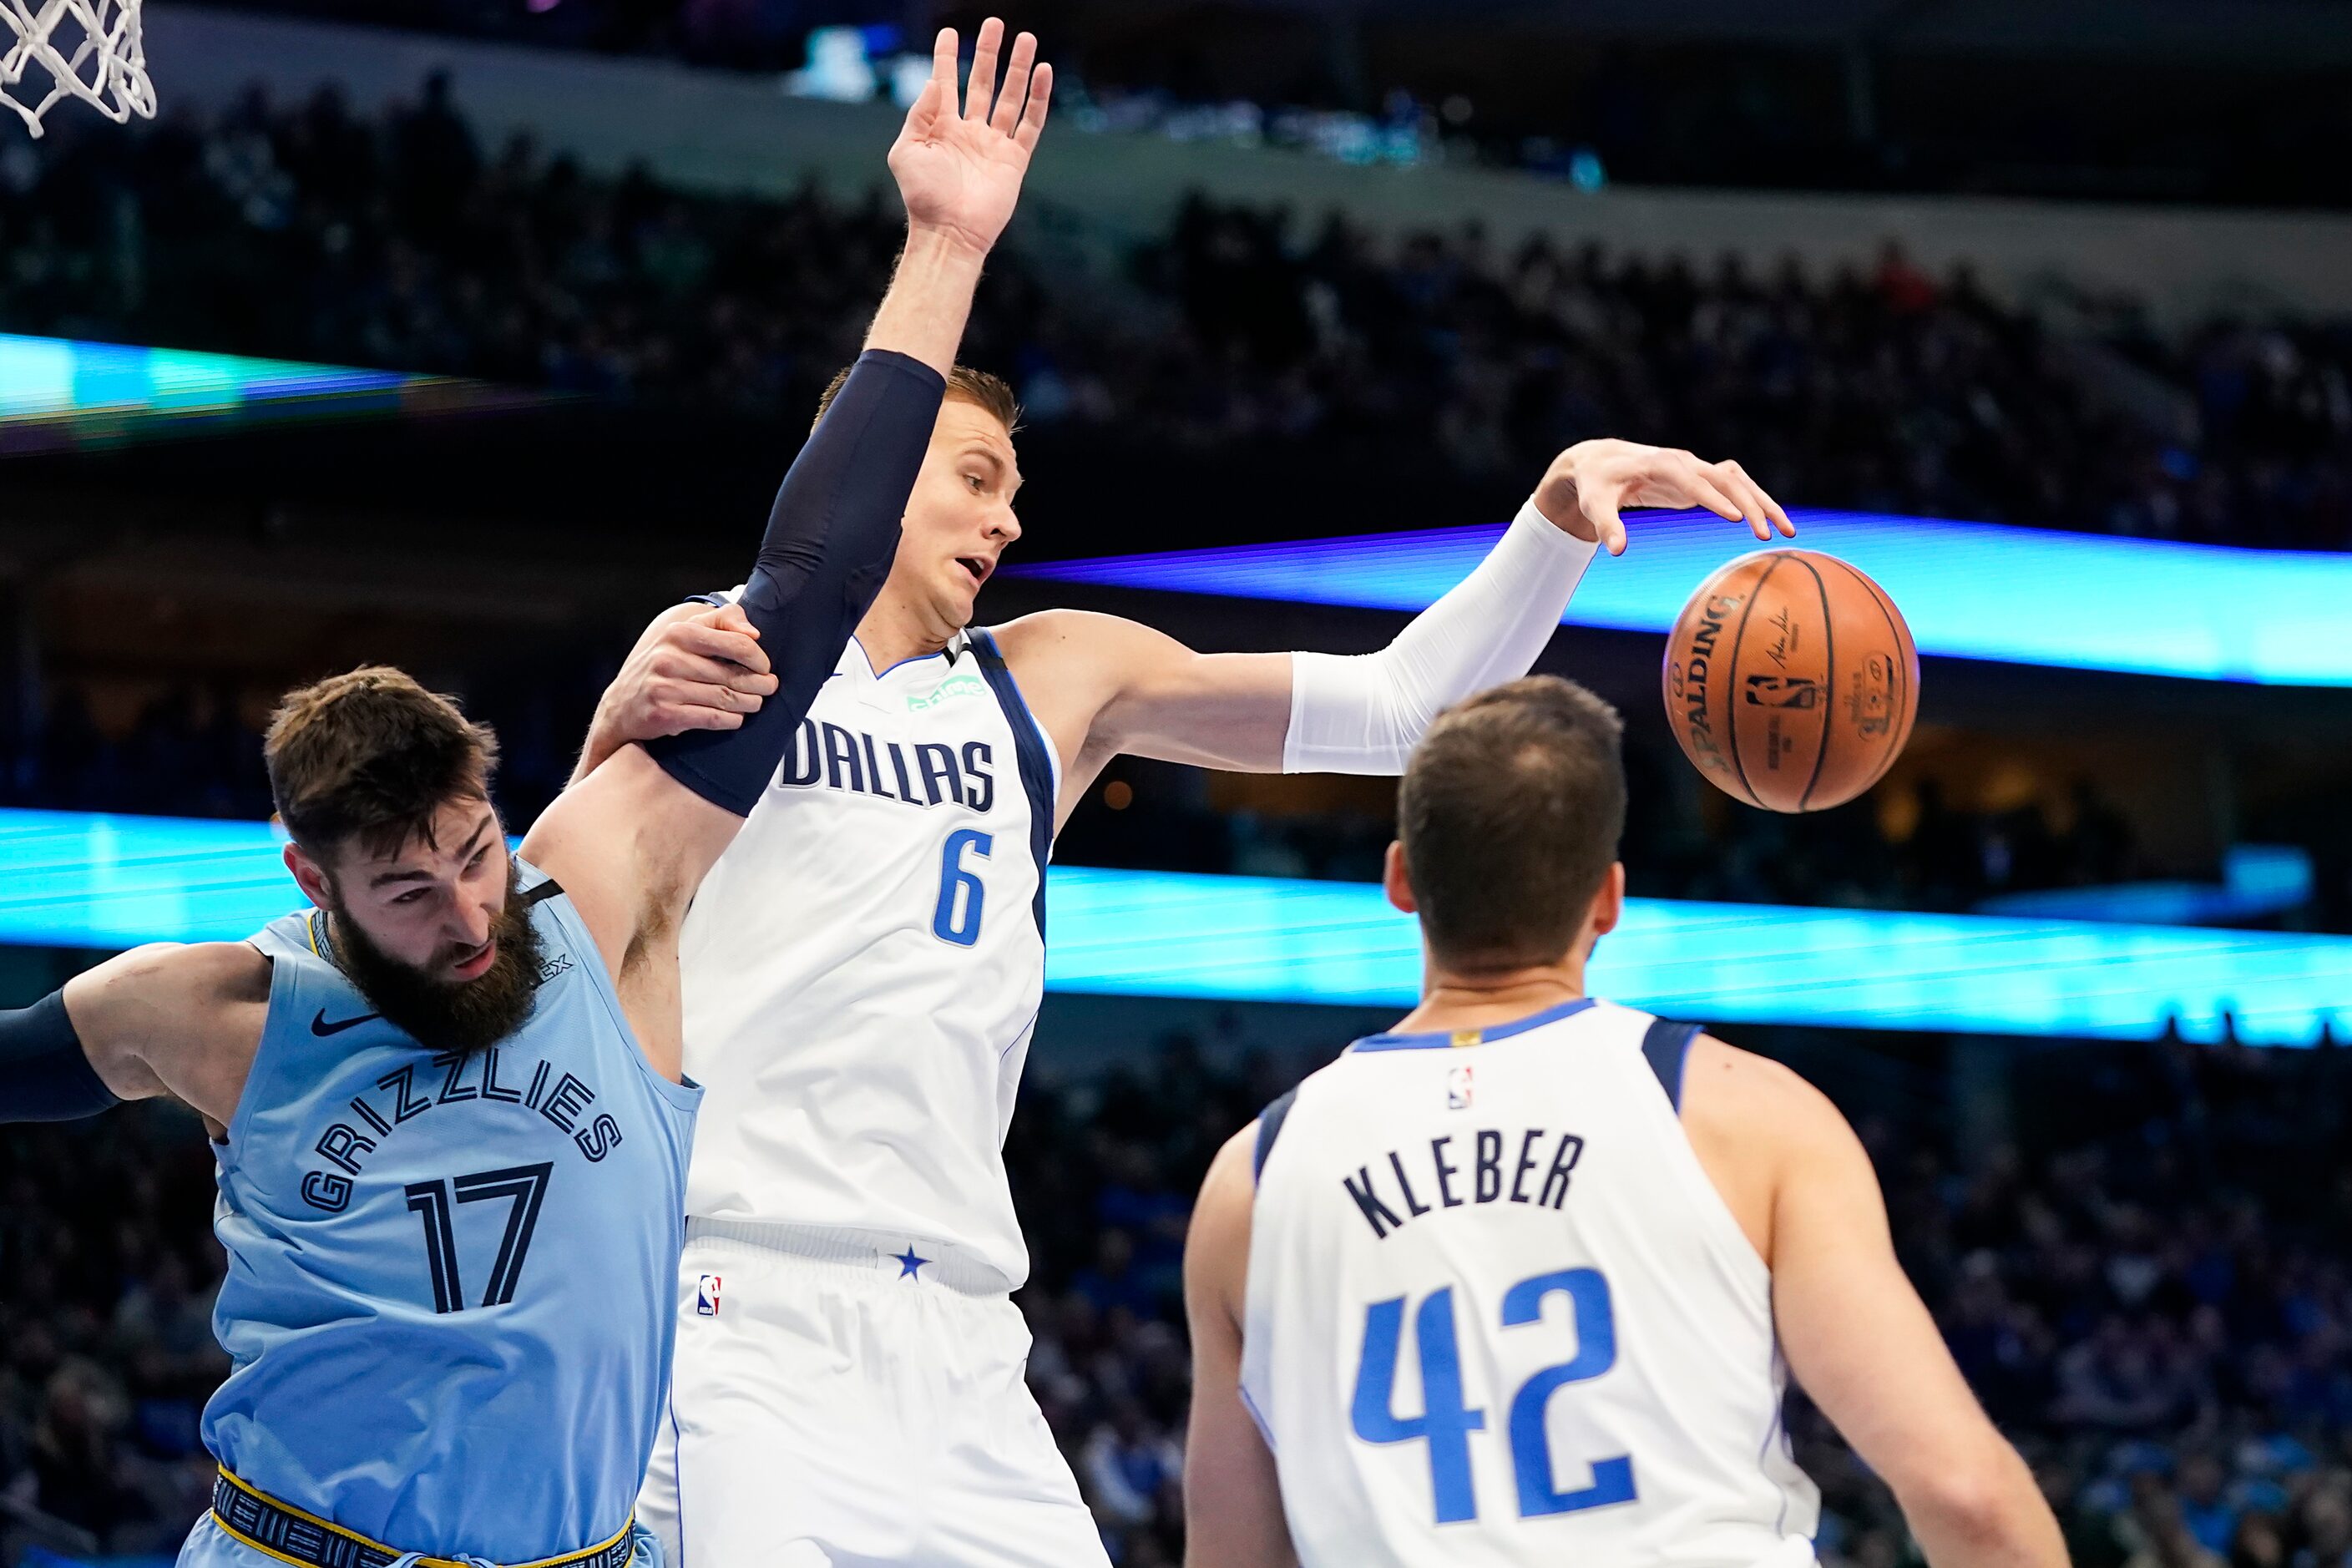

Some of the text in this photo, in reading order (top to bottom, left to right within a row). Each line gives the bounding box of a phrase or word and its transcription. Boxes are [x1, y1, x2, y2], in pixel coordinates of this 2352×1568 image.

[780, 717, 994, 815] DALLAS
[930, 827, 995, 949] 6
[301, 1047, 623, 1213] GRIZZLIES
[1343, 1129, 1585, 1240] KLEBER
[404, 1161, 554, 1314] 17
[1349, 1265, 1640, 1527] 42
